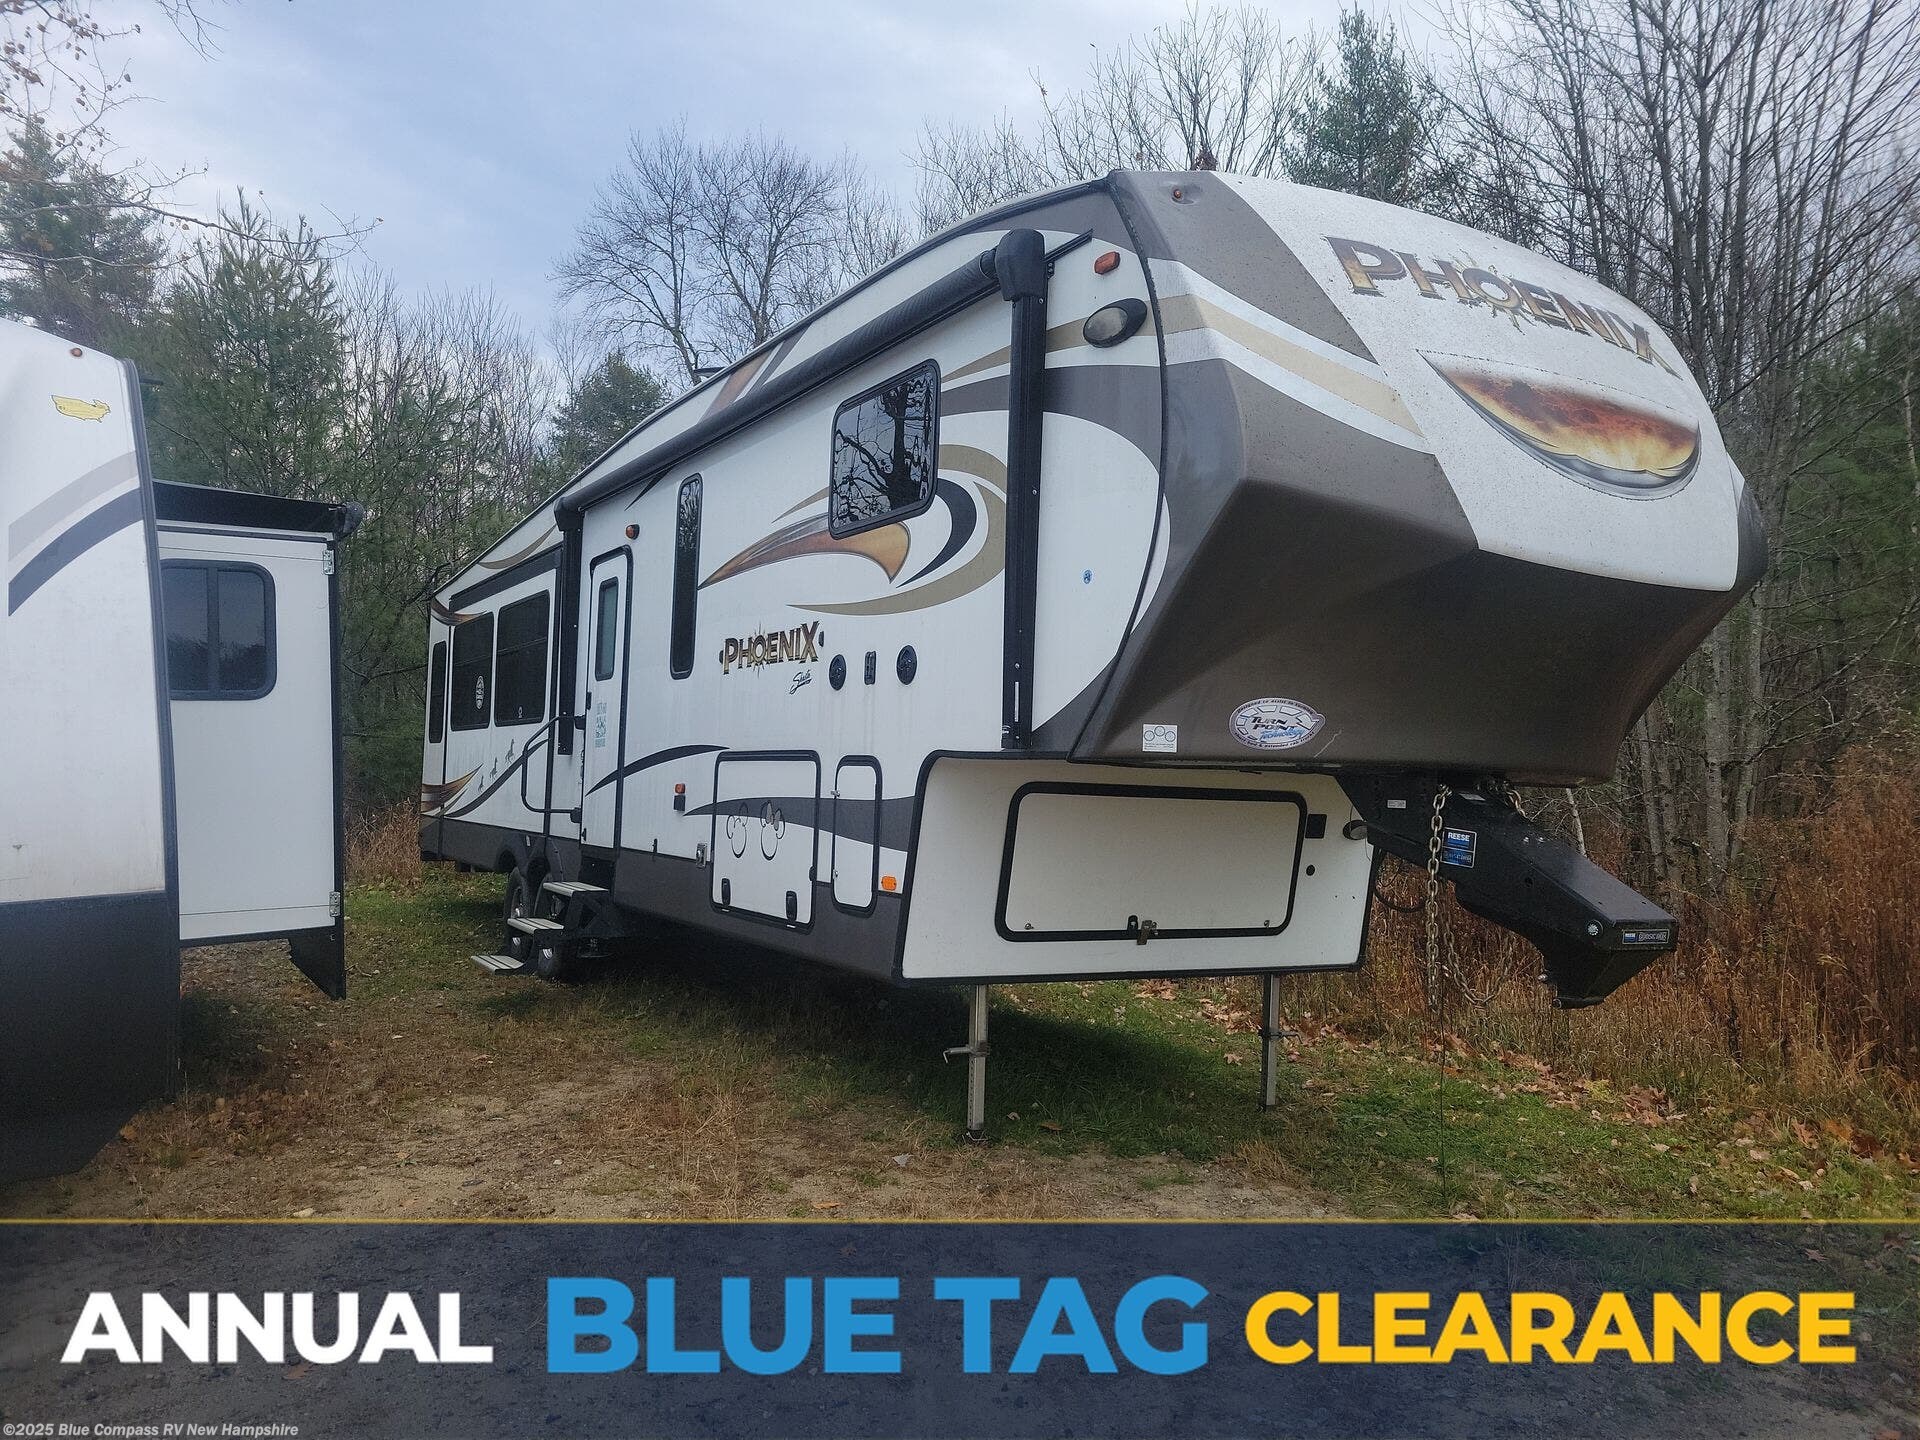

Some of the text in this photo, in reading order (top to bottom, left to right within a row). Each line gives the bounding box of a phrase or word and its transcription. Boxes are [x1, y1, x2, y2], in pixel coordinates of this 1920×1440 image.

[1321, 235, 1681, 381] PHOENIX
[723, 620, 820, 676] PHOENIX
[1447, 831, 1471, 842] REESE
